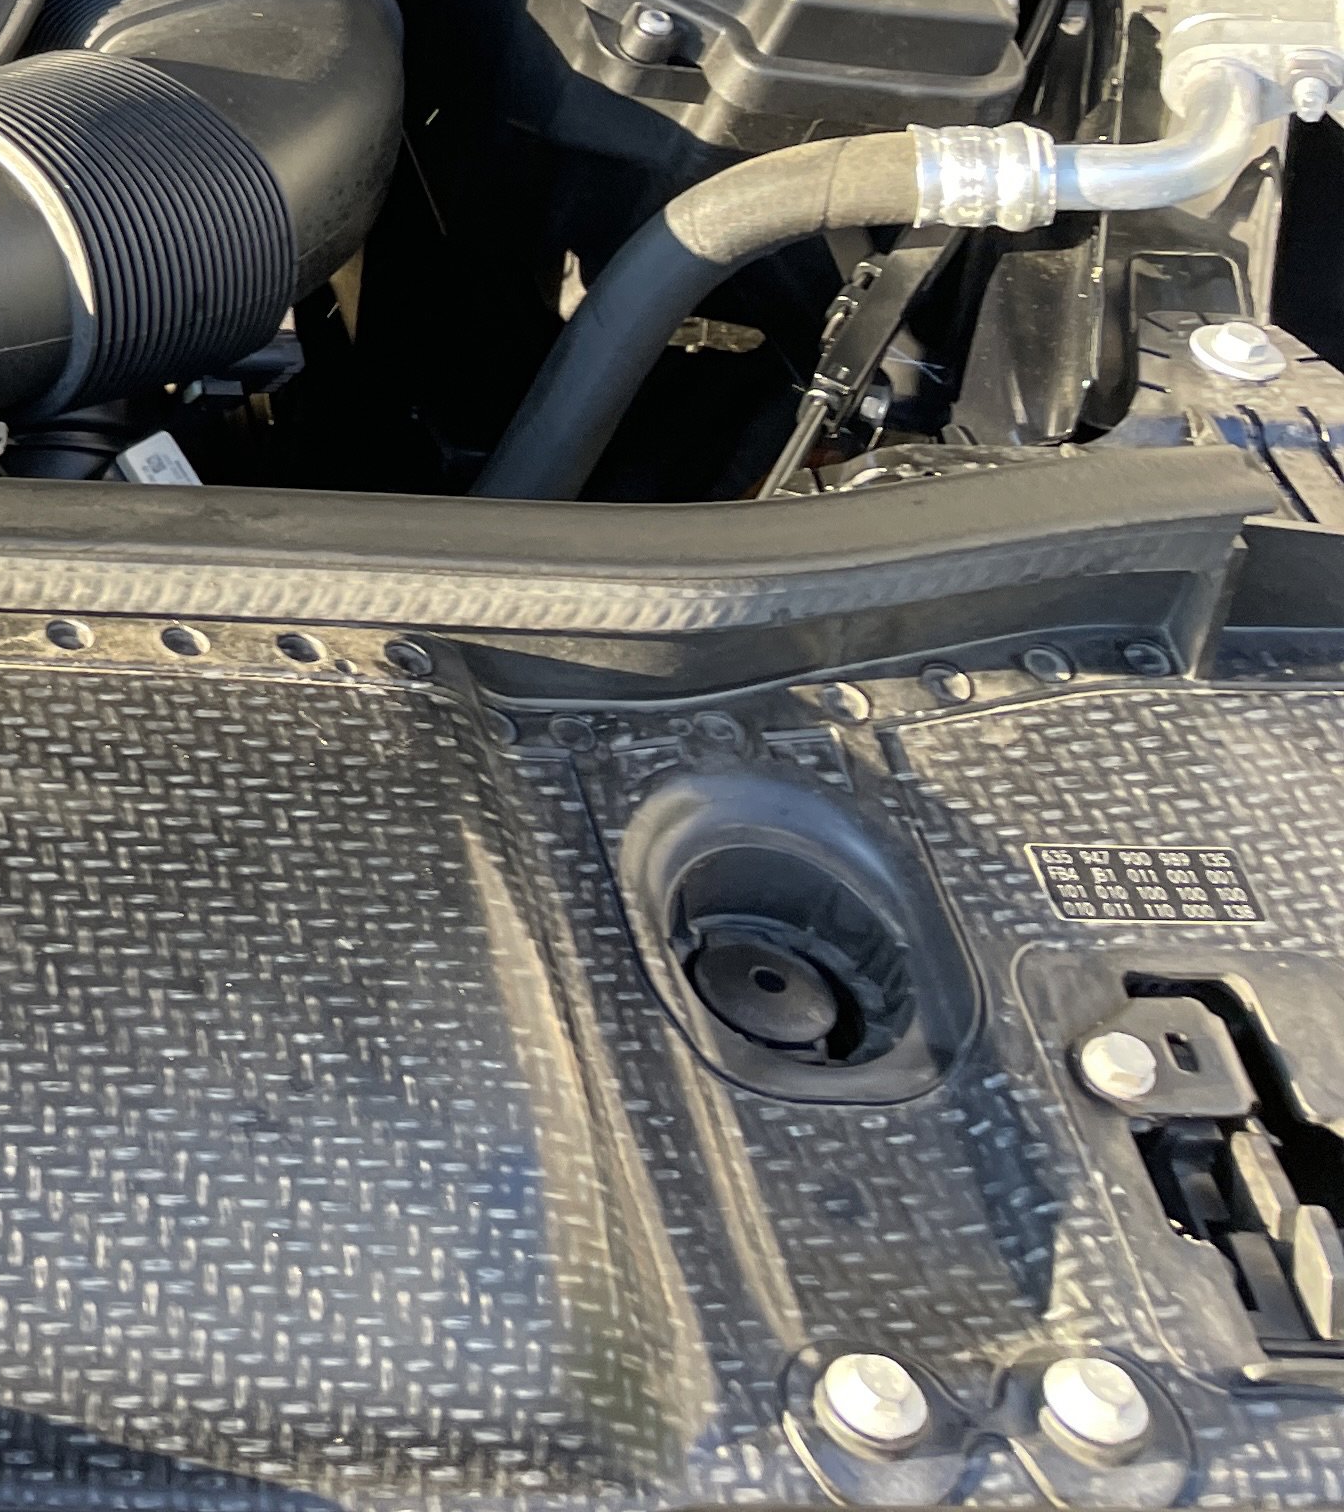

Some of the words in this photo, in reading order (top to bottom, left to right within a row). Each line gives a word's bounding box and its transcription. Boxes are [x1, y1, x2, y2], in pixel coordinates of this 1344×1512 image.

[1126, 869, 1159, 883] 011
[1165, 869, 1199, 884] 001
[1205, 869, 1239, 884] 001
[1056, 884, 1087, 898] 101
[1094, 885, 1128, 900] 010
[1136, 886, 1168, 901] 100
[1176, 886, 1208, 902] 100
[1062, 901, 1096, 916] 010
[1102, 902, 1135, 917] 011
[1144, 903, 1176, 918] 110
